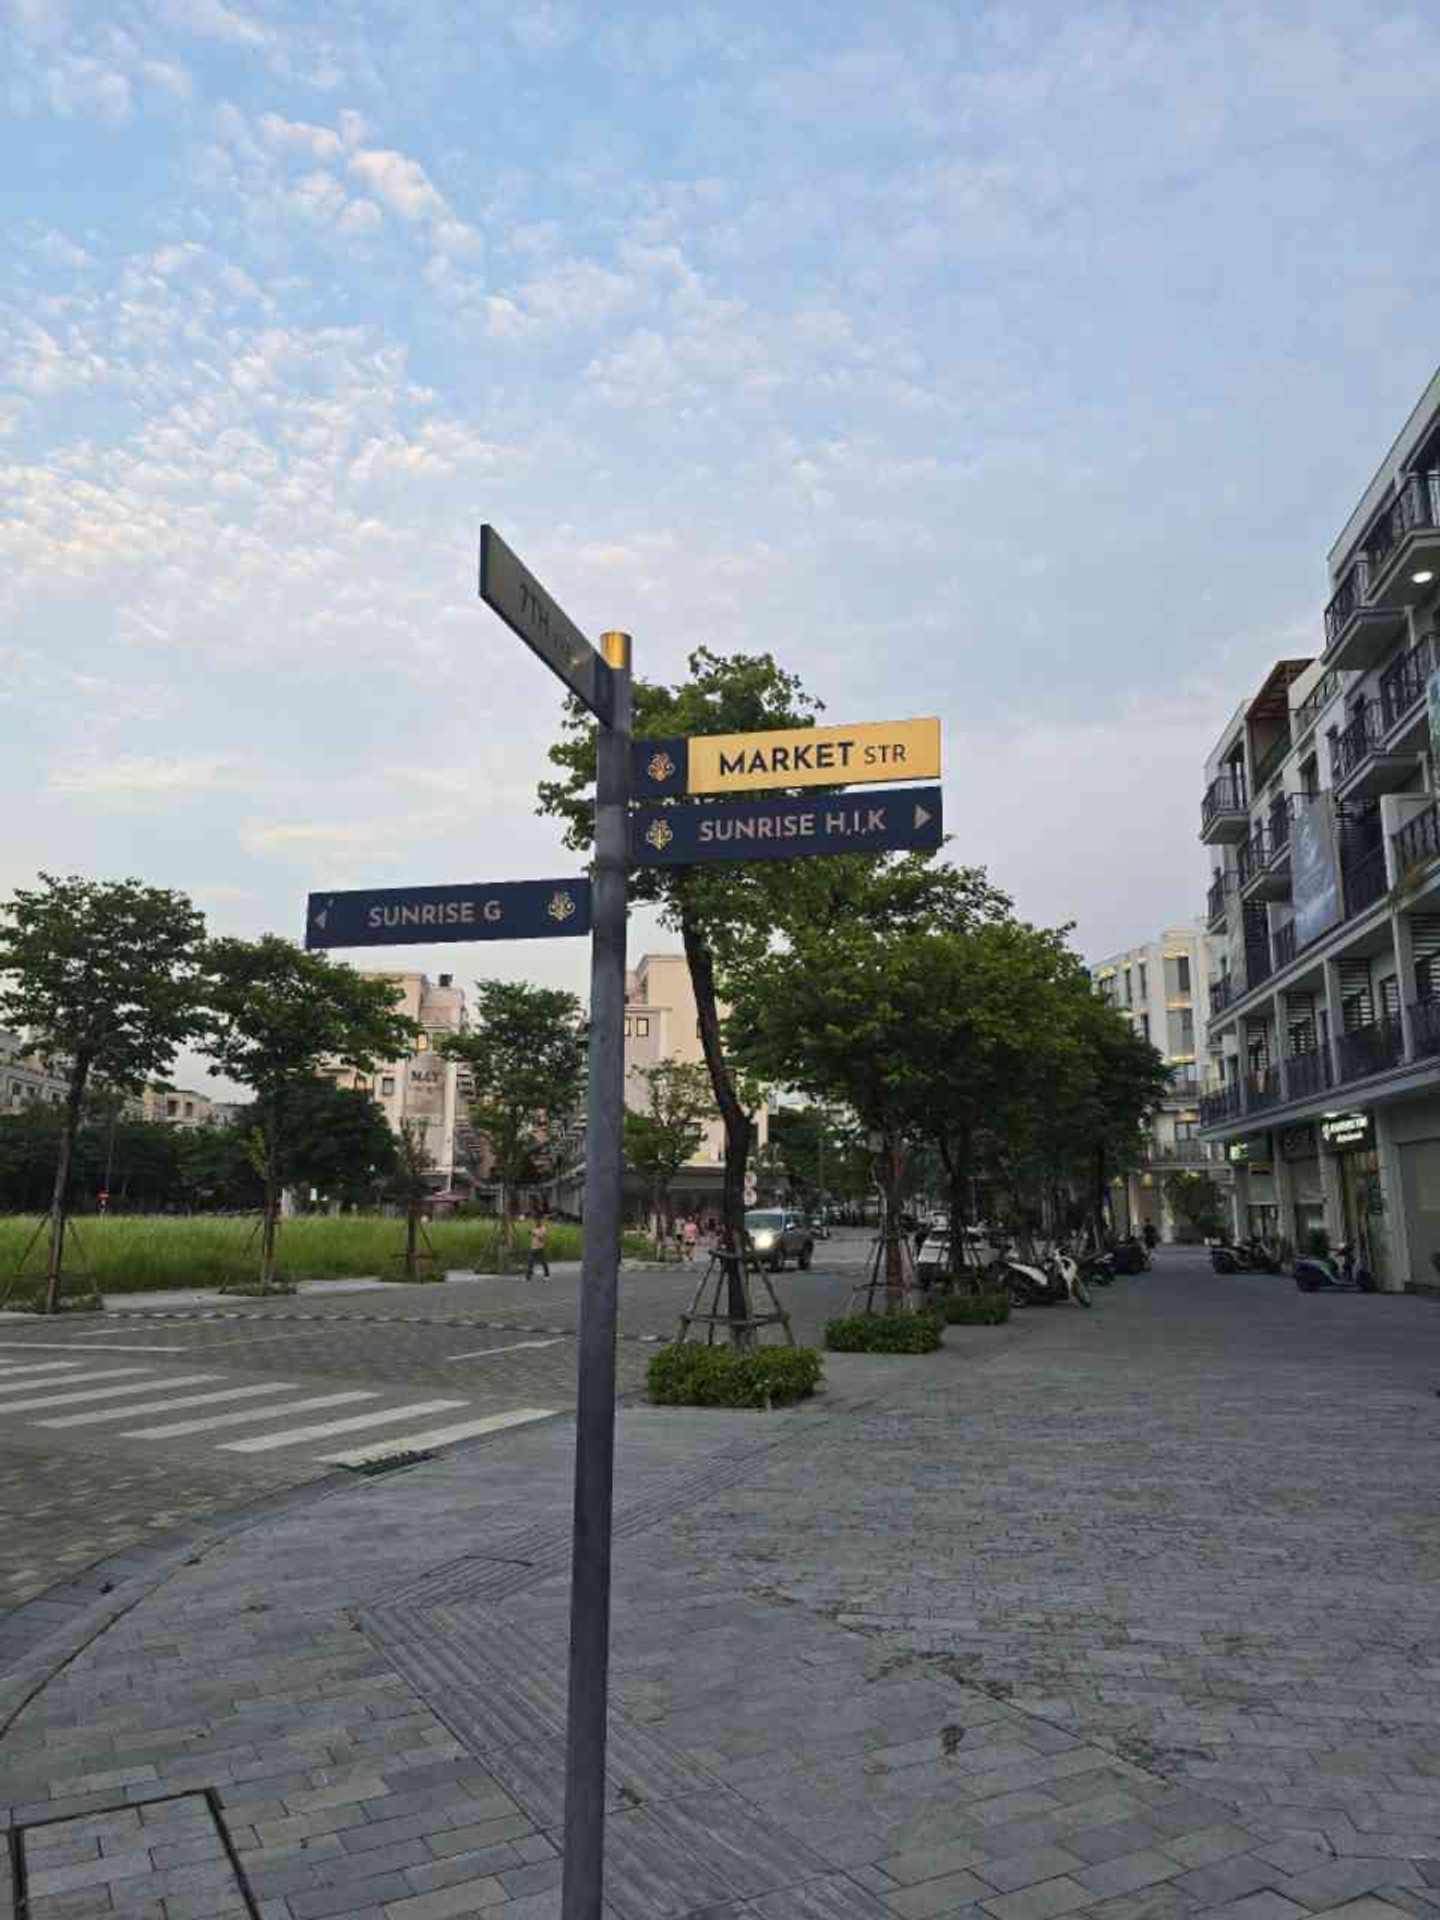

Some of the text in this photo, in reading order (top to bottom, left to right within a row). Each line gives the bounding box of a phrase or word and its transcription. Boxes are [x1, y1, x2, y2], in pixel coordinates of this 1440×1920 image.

[519, 583, 550, 638] 7TH
[719, 741, 907, 776] MARKET STR
[699, 808, 888, 842] SUNRISE H,I,K
[368, 900, 502, 929] SUNRISE G
